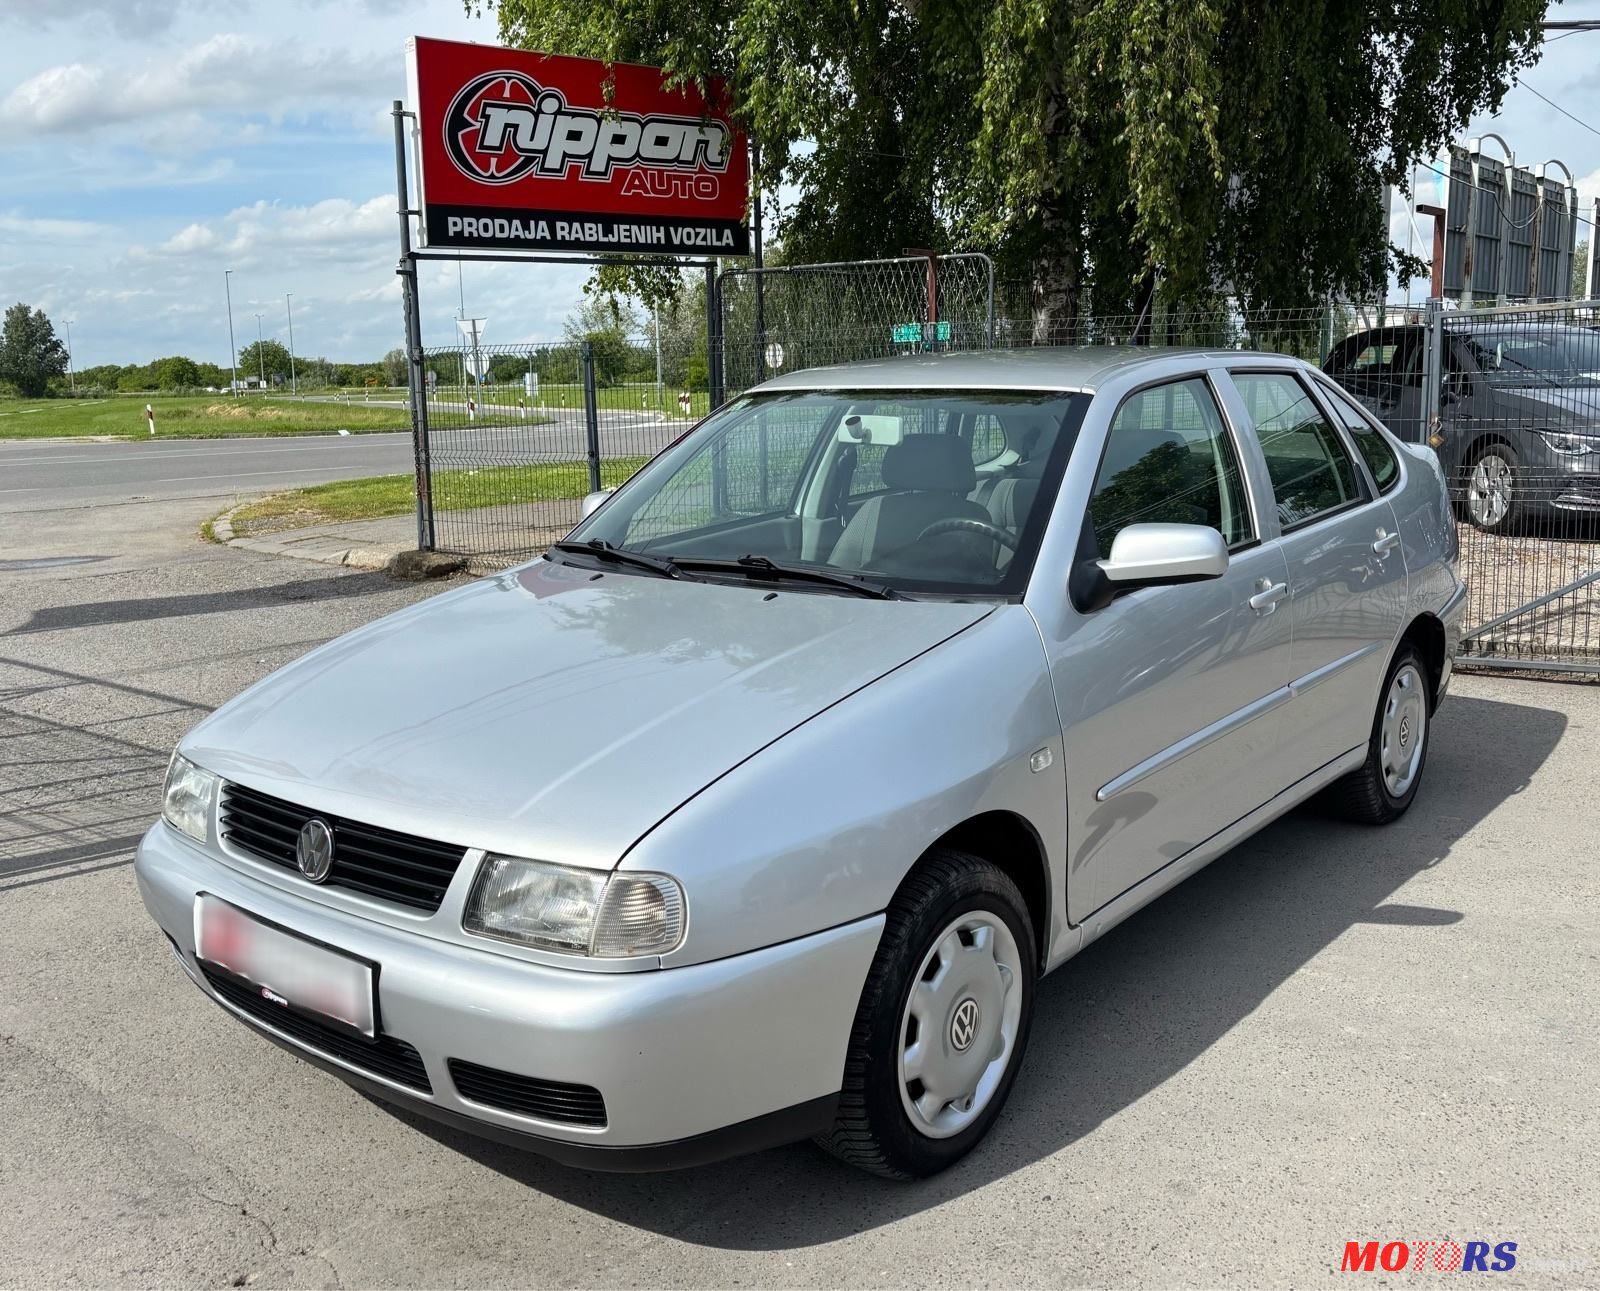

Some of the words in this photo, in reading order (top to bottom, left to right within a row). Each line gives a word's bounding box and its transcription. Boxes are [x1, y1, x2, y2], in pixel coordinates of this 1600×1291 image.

[480, 95, 727, 174] nippon
[621, 169, 719, 200] AUTO
[447, 216, 551, 240] PRODAJA
[556, 221, 665, 245] RABLJENIH
[670, 227, 734, 247] VOZILA
